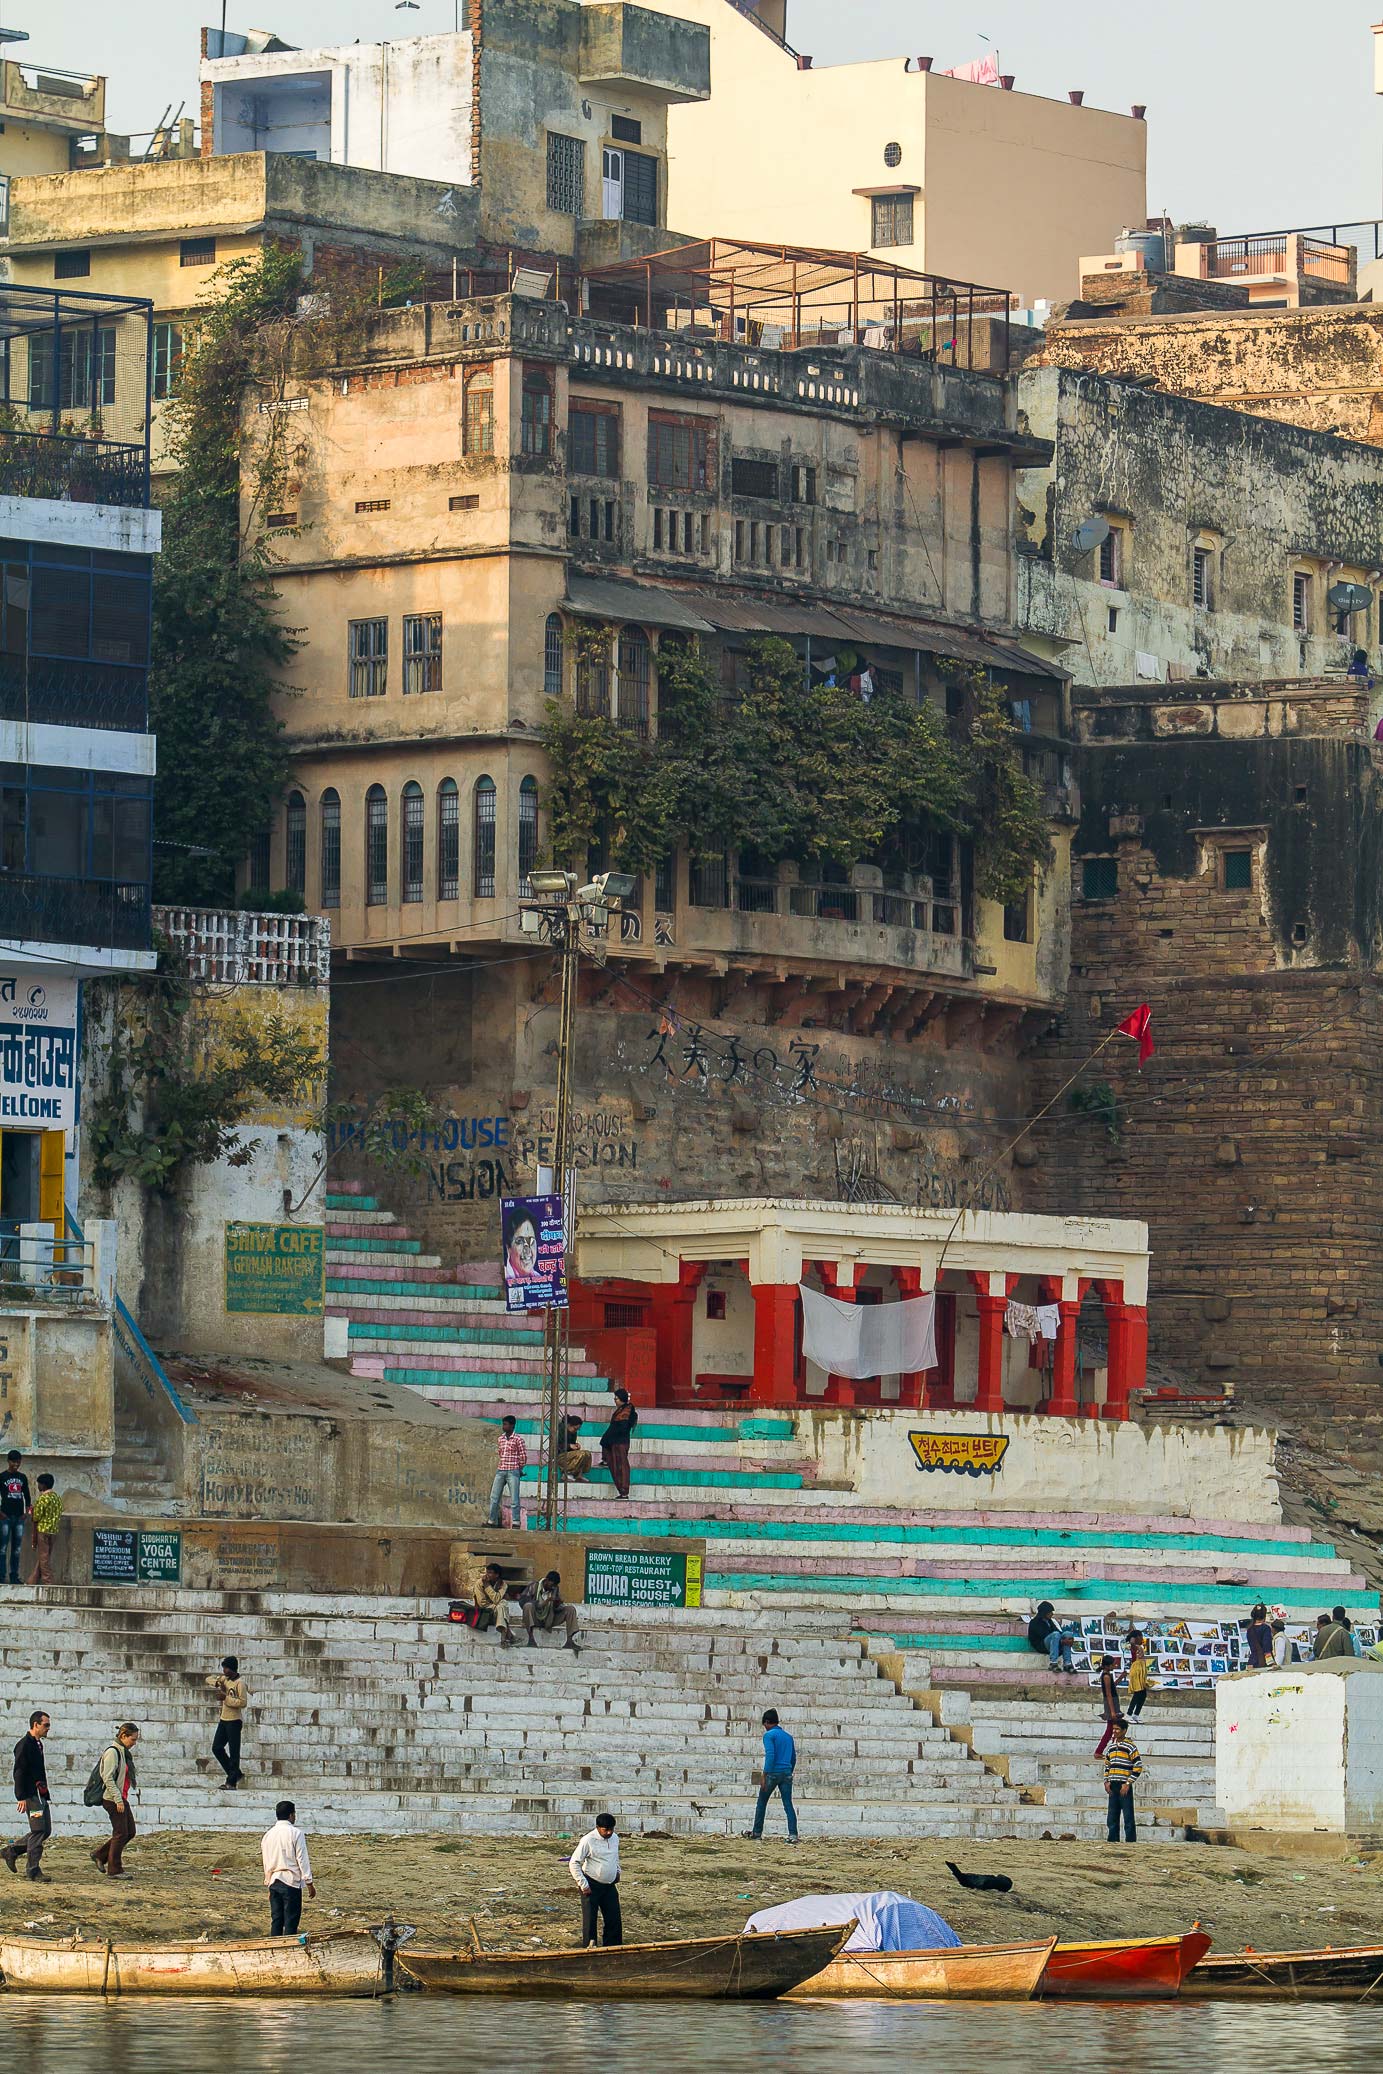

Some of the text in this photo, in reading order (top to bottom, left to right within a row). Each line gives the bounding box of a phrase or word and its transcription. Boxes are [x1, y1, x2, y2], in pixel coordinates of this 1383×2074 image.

[0, 1093, 62, 1119] ELCOME
[280, 1232, 320, 1253] CAFE
[918, 1437, 941, 1459] 철수
[941, 1440, 969, 1455] 최고의
[143, 1544, 173, 1557] YOGA
[141, 1557, 177, 1569] CENTRE
[589, 1552, 672, 1566] BROWN BREAD BAKERY
[624, 1566, 671, 1575] RESTAURANT
[588, 1573, 629, 1596] RUDRA
[631, 1579, 672, 1590] GUEST
[631, 1589, 670, 1601] HOUSE
